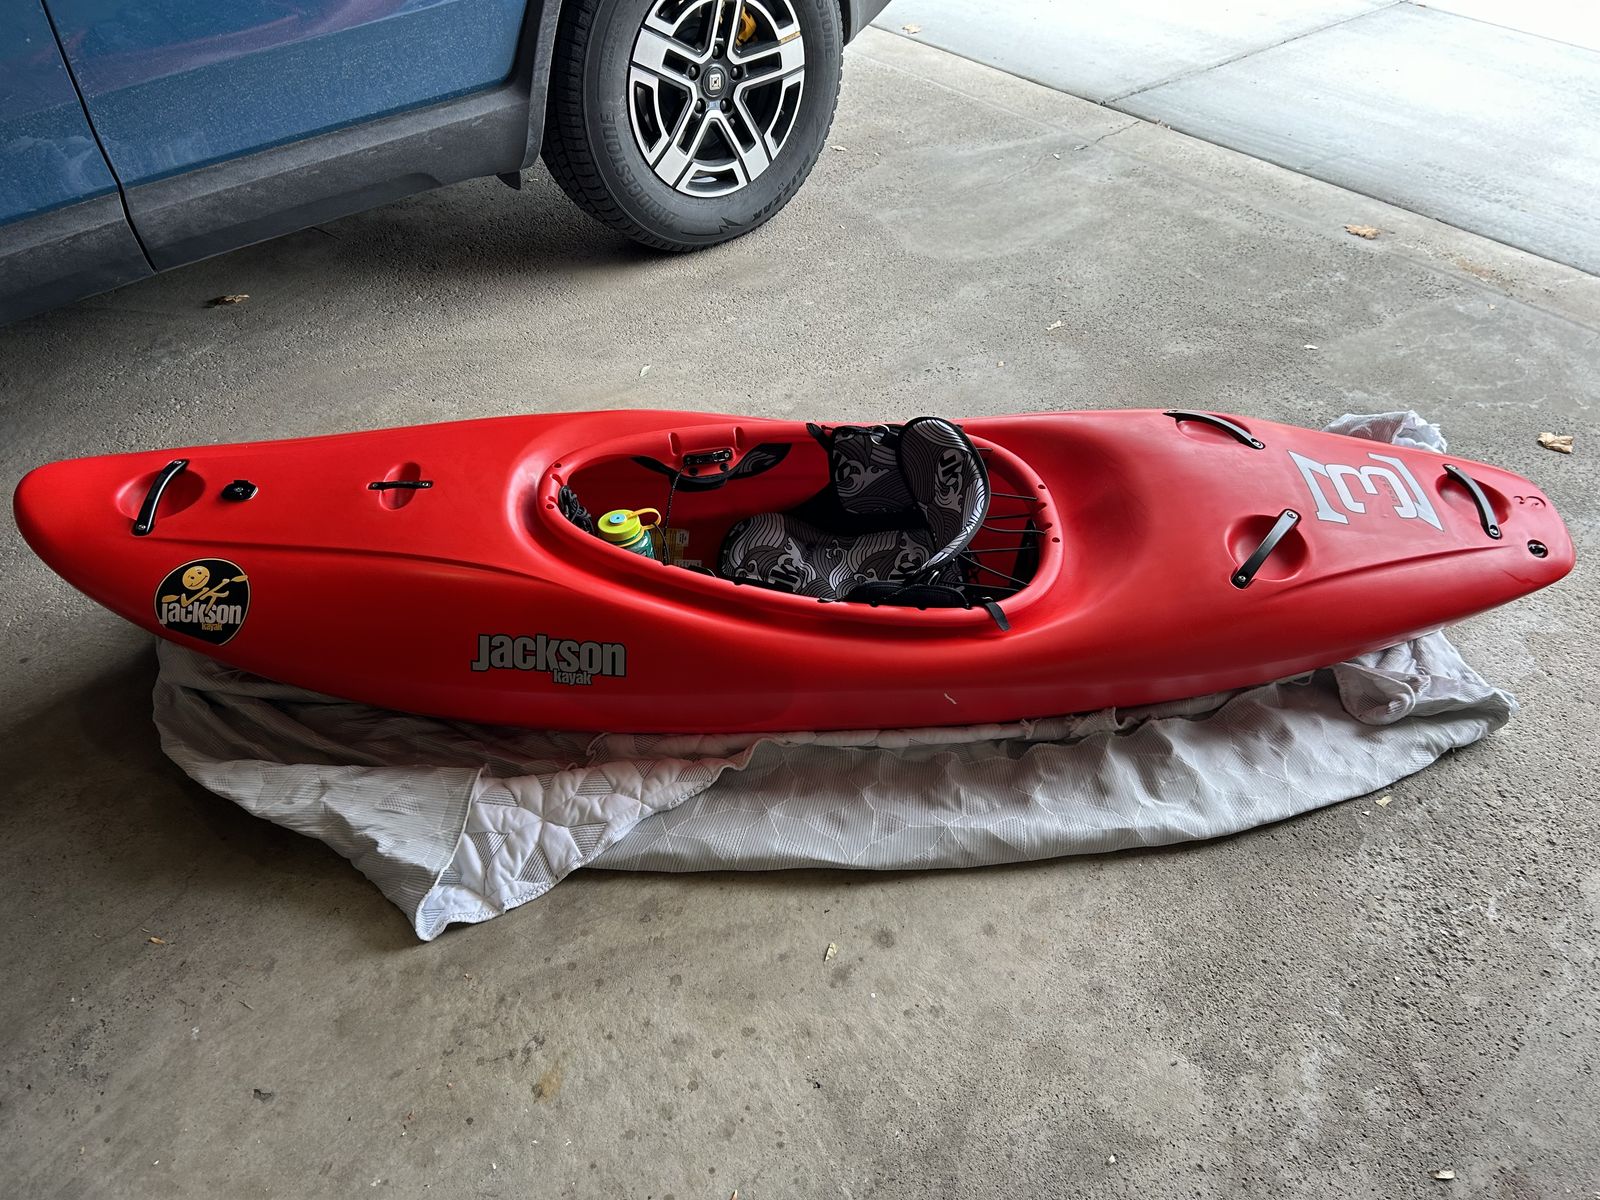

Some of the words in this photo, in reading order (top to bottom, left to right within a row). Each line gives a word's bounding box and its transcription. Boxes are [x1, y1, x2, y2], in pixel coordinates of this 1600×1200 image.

[750, 153, 812, 221] BLIZZAK
[159, 601, 242, 625] jackson
[471, 634, 626, 677] jackson
[552, 668, 593, 686] kayak
